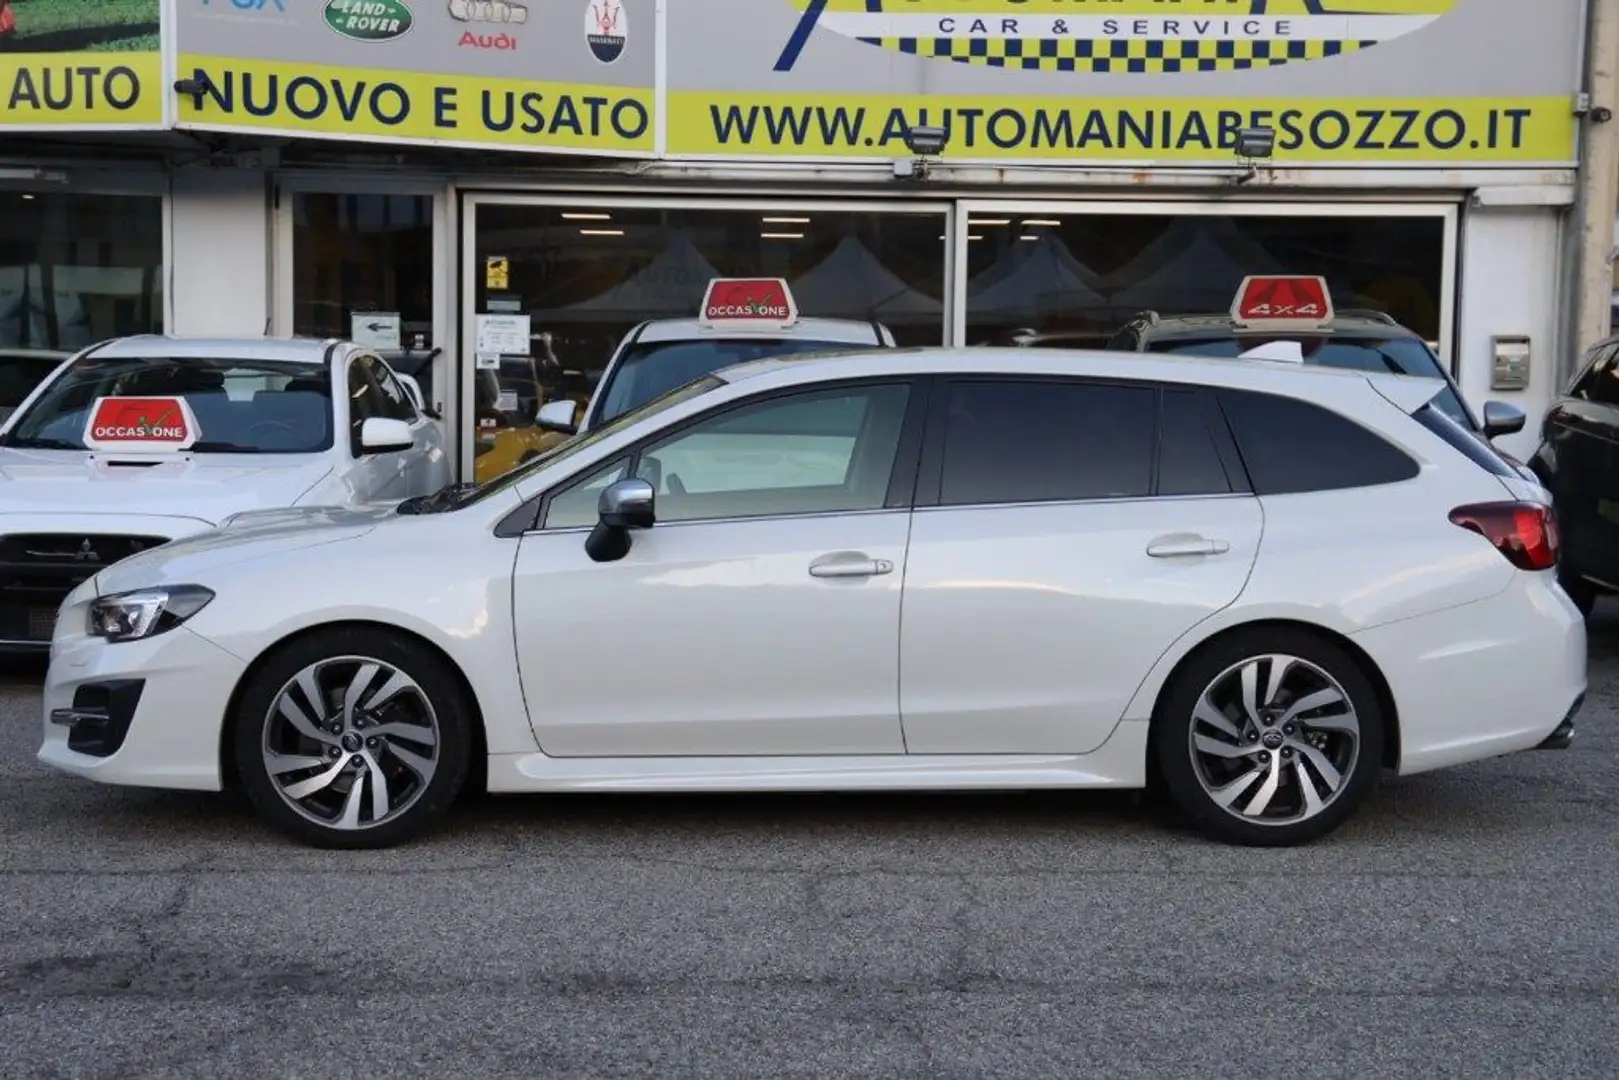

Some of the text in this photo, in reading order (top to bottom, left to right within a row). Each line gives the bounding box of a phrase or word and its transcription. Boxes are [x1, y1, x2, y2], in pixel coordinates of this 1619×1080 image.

[341, 0, 386, 16] LAND
[345, 15, 400, 33] ROVER
[938, 17, 1290, 35] CAR & SERVICE
[458, 31, 517, 50] Audi
[7, 66, 141, 111] AUTO
[192, 68, 648, 139] NUOVO E USATO
[708, 304, 787, 316] OCCASONE
[94, 426, 183, 438] OCCASONE
